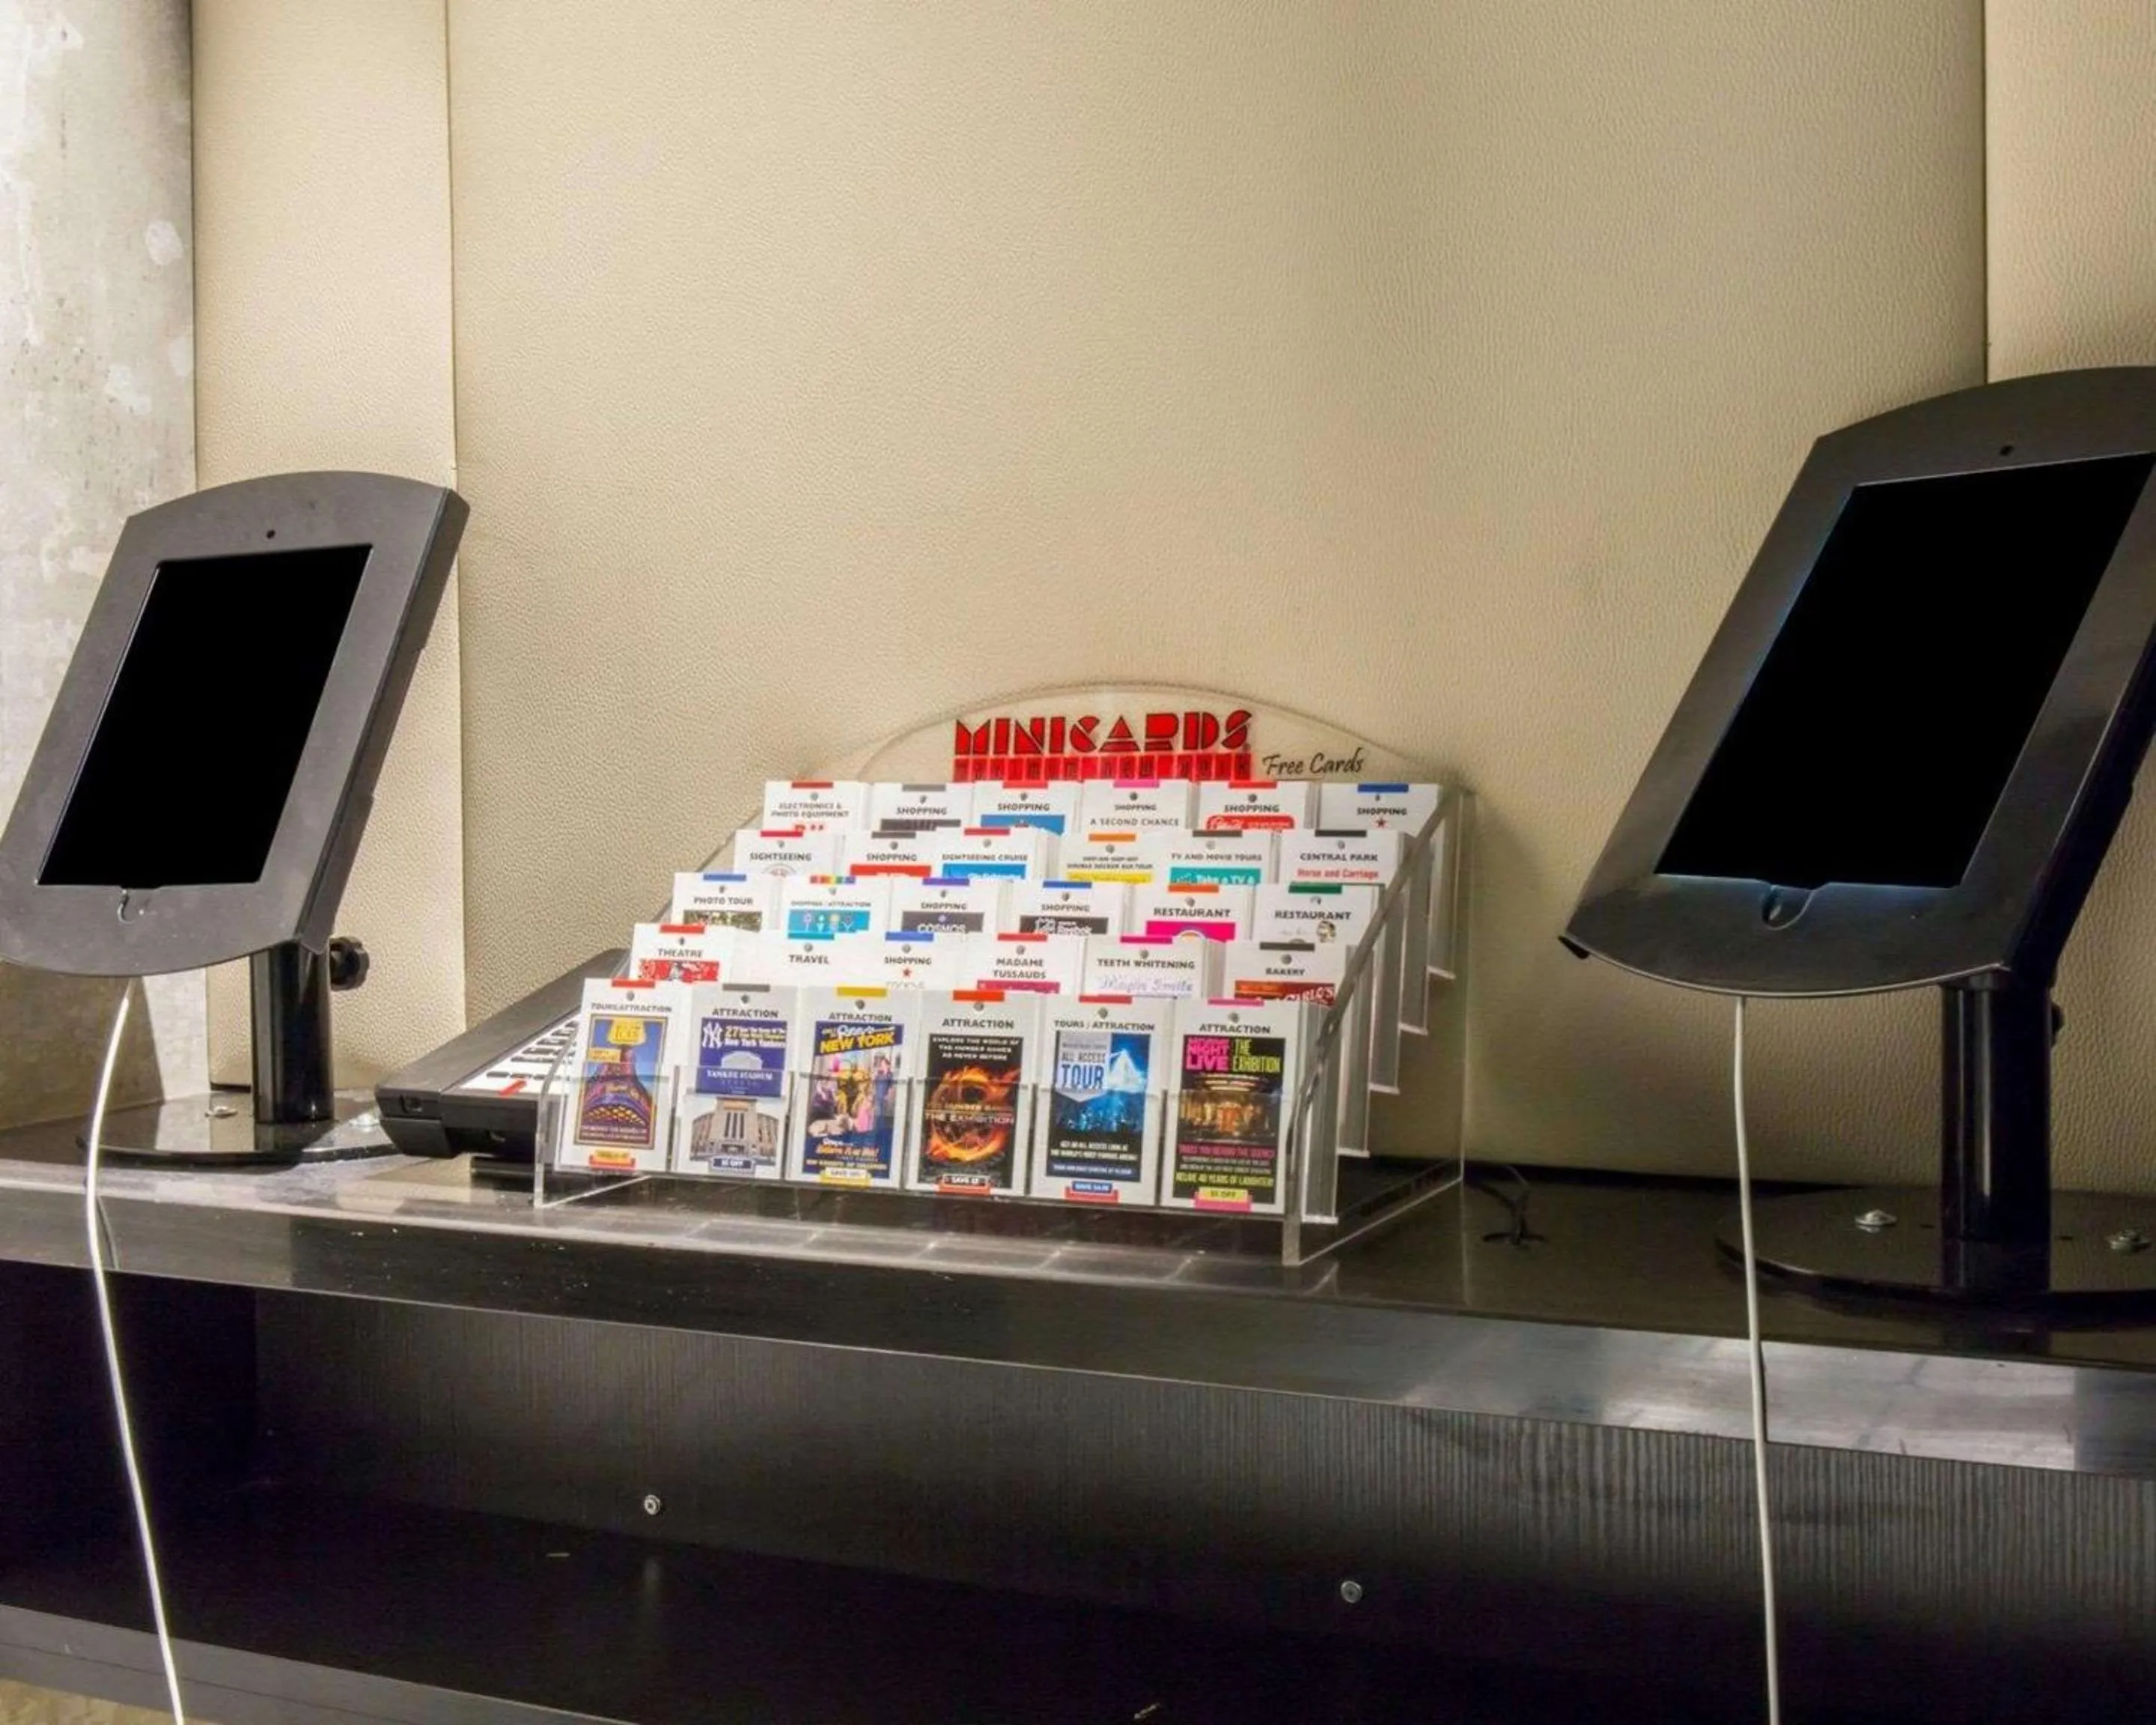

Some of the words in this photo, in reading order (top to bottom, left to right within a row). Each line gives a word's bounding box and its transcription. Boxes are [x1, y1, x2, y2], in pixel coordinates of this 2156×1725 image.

[954, 709, 1252, 755] MINICARDS
[1262, 753, 1304, 776] Free
[1310, 747, 1363, 774] Cards
[896, 806, 948, 815] SHOPPING
[997, 803, 1051, 812] SHOPPING
[1224, 804, 1280, 813] SHOPPING
[1356, 807, 1408, 816] SHOPPING
[1090, 818, 1097, 827] A
[1100, 818, 1139, 827] SECOND
[1142, 818, 1180, 827] CHANCE
[749, 852, 813, 862] SIGHTSEEING
[865, 853, 918, 862] SHOPPING
[1234, 853, 1263, 861] TOURS
[1300, 853, 1348, 862] CENTRAL
[1350, 853, 1379, 862] PARK
[1297, 868, 1322, 877] Horse
[1324, 868, 1340, 877] and
[1342, 868, 1380, 880] Carriage
[693, 897, 726, 905] PHOTO
[728, 897, 754, 905] TOUR
[920, 901, 967, 910] SHOPPING
[1041, 904, 1091, 912] SHOPPING
[1154, 907, 1231, 918] RESTAURANT
[1274, 910, 1352, 920] RESTAURANT
[658, 948, 703, 958] THEATRE
[788, 954, 830, 964] TRAVEL
[884, 956, 932, 965] SHOPPING
[996, 958, 1044, 967] MADAME
[1097, 958, 1131, 967] TEETH
[1134, 958, 1196, 970] WHITENING
[993, 970, 1047, 979] TUSSAUDS
[1265, 967, 1306, 976] BAKERY
[712, 1008, 779, 1018] ATTRACTION
[828, 1011, 892, 1022] ATTRACTION
[942, 1017, 1014, 1029] ATTRACTION
[1054, 1020, 1085, 1028] TOURS
[1092, 1021, 1156, 1031] ATTRACTION
[1199, 1023, 1271, 1034] ATTRACTION
[820, 1035, 853, 1053] NEW
[856, 1031, 895, 1048] YORK
[1236, 1038, 1252, 1056] THE
[1186, 1054, 1229, 1071] LIVE
[1062, 1064, 1104, 1089] TOUR
